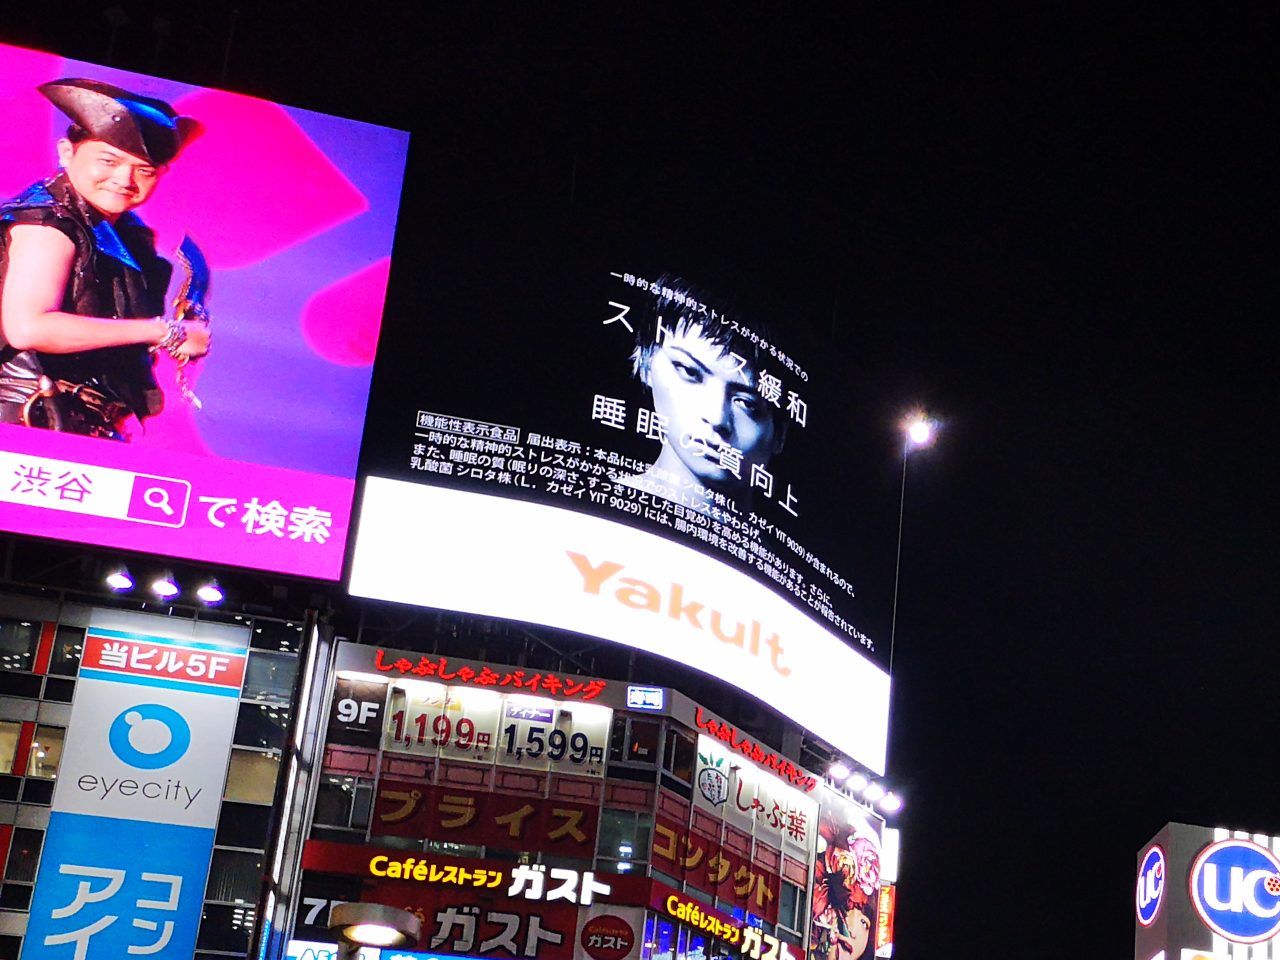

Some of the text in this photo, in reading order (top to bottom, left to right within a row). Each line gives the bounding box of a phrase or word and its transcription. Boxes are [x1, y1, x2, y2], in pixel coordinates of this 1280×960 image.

[602, 300, 808, 428] ストス緩和
[419, 413, 518, 442] 機能性表示食品
[9, 464, 93, 503] 渋谷
[198, 495, 333, 545] で検索
[565, 550, 793, 677] Yakult
[99, 641, 230, 680] 当ビル5F
[374, 650, 608, 700] しゃぶしゃぶバイキング
[337, 698, 380, 726] 9F
[391, 709, 491, 751] 1,199円
[503, 723, 604, 766] 1,599円
[78, 773, 202, 809] eyecity
[736, 777, 807, 842] しゃぶ葉
[379, 789, 590, 844] プライス
[368, 855, 612, 905] Caféレストラン ガスト
[653, 823, 773, 908] コンタクト
[428, 905, 564, 958] ガスト
